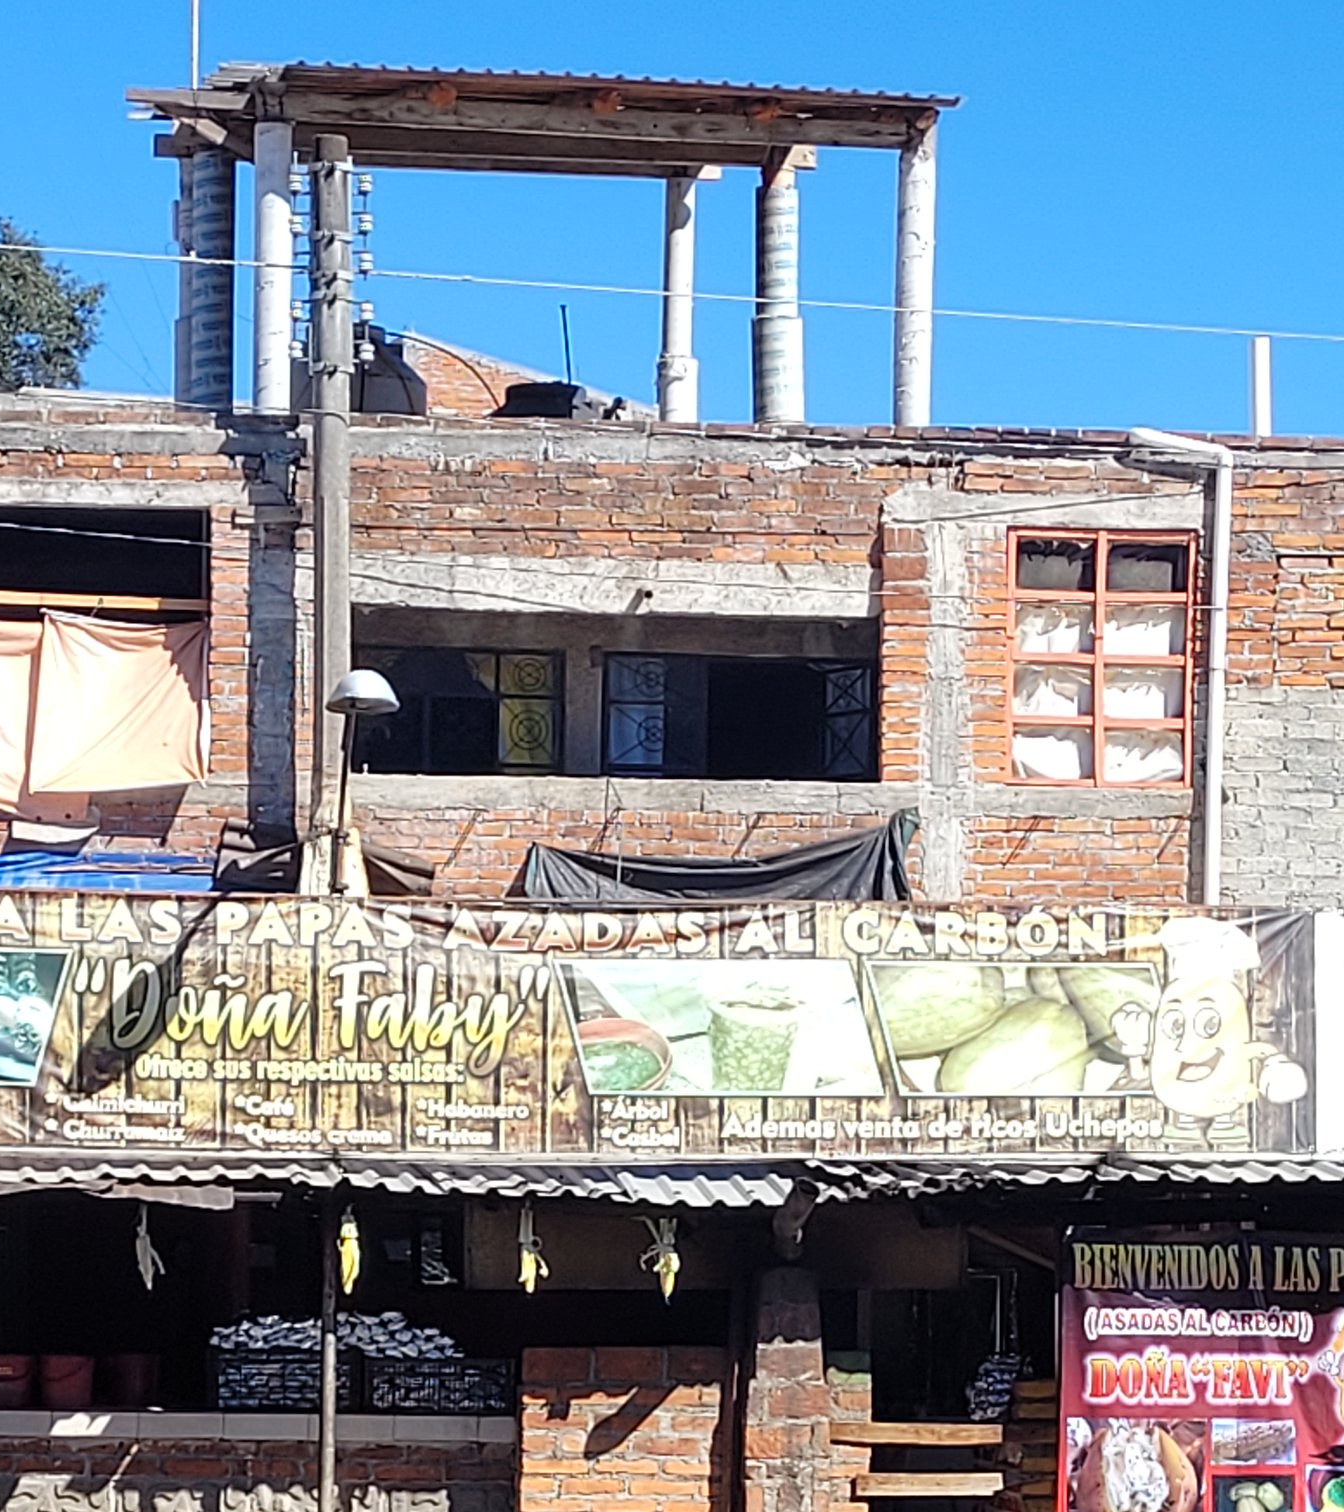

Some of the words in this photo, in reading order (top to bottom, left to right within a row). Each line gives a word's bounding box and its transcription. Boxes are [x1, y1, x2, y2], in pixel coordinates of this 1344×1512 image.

[59, 897, 183, 945] LAS
[216, 900, 416, 949] PAPAS
[442, 908, 708, 955] AZADAS
[735, 908, 816, 953] AL
[842, 904, 1108, 958] CARBÓN
[136, 1054, 207, 1081] Ofrece
[213, 1060, 252, 1081] sus
[246, 1095, 295, 1117] Café
[428, 1098, 529, 1119] Habanero
[610, 1096, 668, 1120] Árbol
[244, 1122, 322, 1147] Quesos
[327, 1128, 394, 1145] crema
[428, 1127, 494, 1145] Frutas
[721, 1112, 838, 1140] Ademas
[842, 1115, 920, 1139] venta
[928, 1113, 964, 1138] de
[971, 1113, 1037, 1139] ricos
[1046, 1112, 1164, 1142] Uchepos
[1073, 1243, 1239, 1290] BIENVENIDOS
[1248, 1245, 1266, 1290] A
[1273, 1245, 1320, 1292] LAS
[1185, 1312, 1208, 1333] AL
[1088, 1350, 1190, 1399] DOÑA
